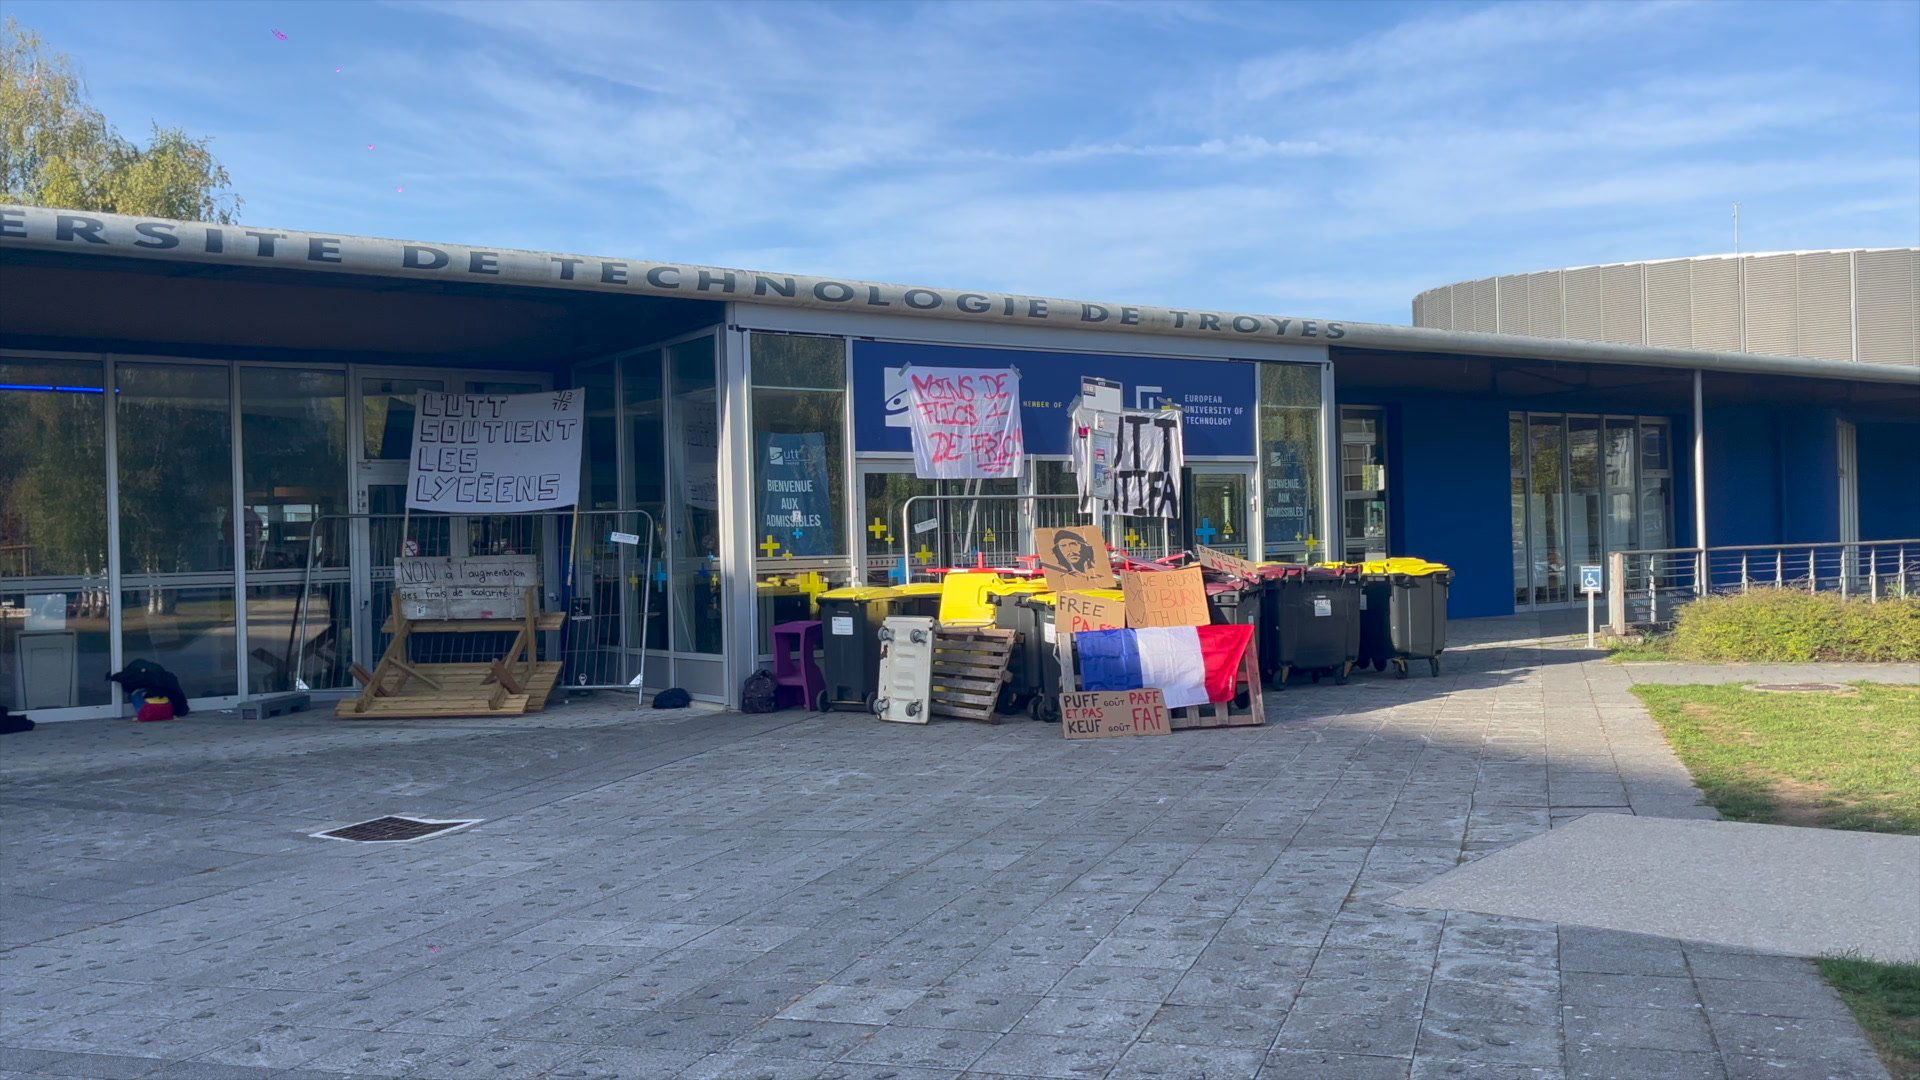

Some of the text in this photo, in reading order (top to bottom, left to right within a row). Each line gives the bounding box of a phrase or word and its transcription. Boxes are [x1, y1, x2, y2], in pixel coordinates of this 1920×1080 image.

[402, 246, 500, 275] DE
[551, 258, 1048, 319] TECHNOLOGIE
[1081, 303, 1139, 325] DE
[1169, 310, 1345, 339] TROYES
[911, 373, 1009, 402] MOINS DE
[1184, 394, 1223, 403] EUROPEAN
[1184, 405, 1244, 415] UNIVERSITY OF
[420, 418, 578, 443] SOUTIENT
[1185, 416, 1232, 426] TECHNOLOGY
[929, 432, 964, 463] DE
[418, 446, 479, 473] LES
[416, 472, 561, 502] LYCÉENS
[767, 479, 813, 492] BIENVENUE
[1267, 478, 1300, 489] BIENVENUE
[781, 497, 799, 510] AUX
[400, 561, 437, 582] NON
[1165, 571, 1200, 588] BURN
[401, 590, 418, 600] des
[453, 587, 463, 597] de
[470, 588, 509, 599] scolarité
[1160, 588, 1202, 608] BURN
[1060, 595, 1105, 617] FREE
[1126, 606, 1171, 627] WTH
[1064, 693, 1099, 708] PUFF
[1129, 691, 1160, 705] PAFF
[1065, 707, 1104, 719] ET PAS
[1068, 719, 1101, 734] KEUF
[1132, 705, 1163, 731] FAF
